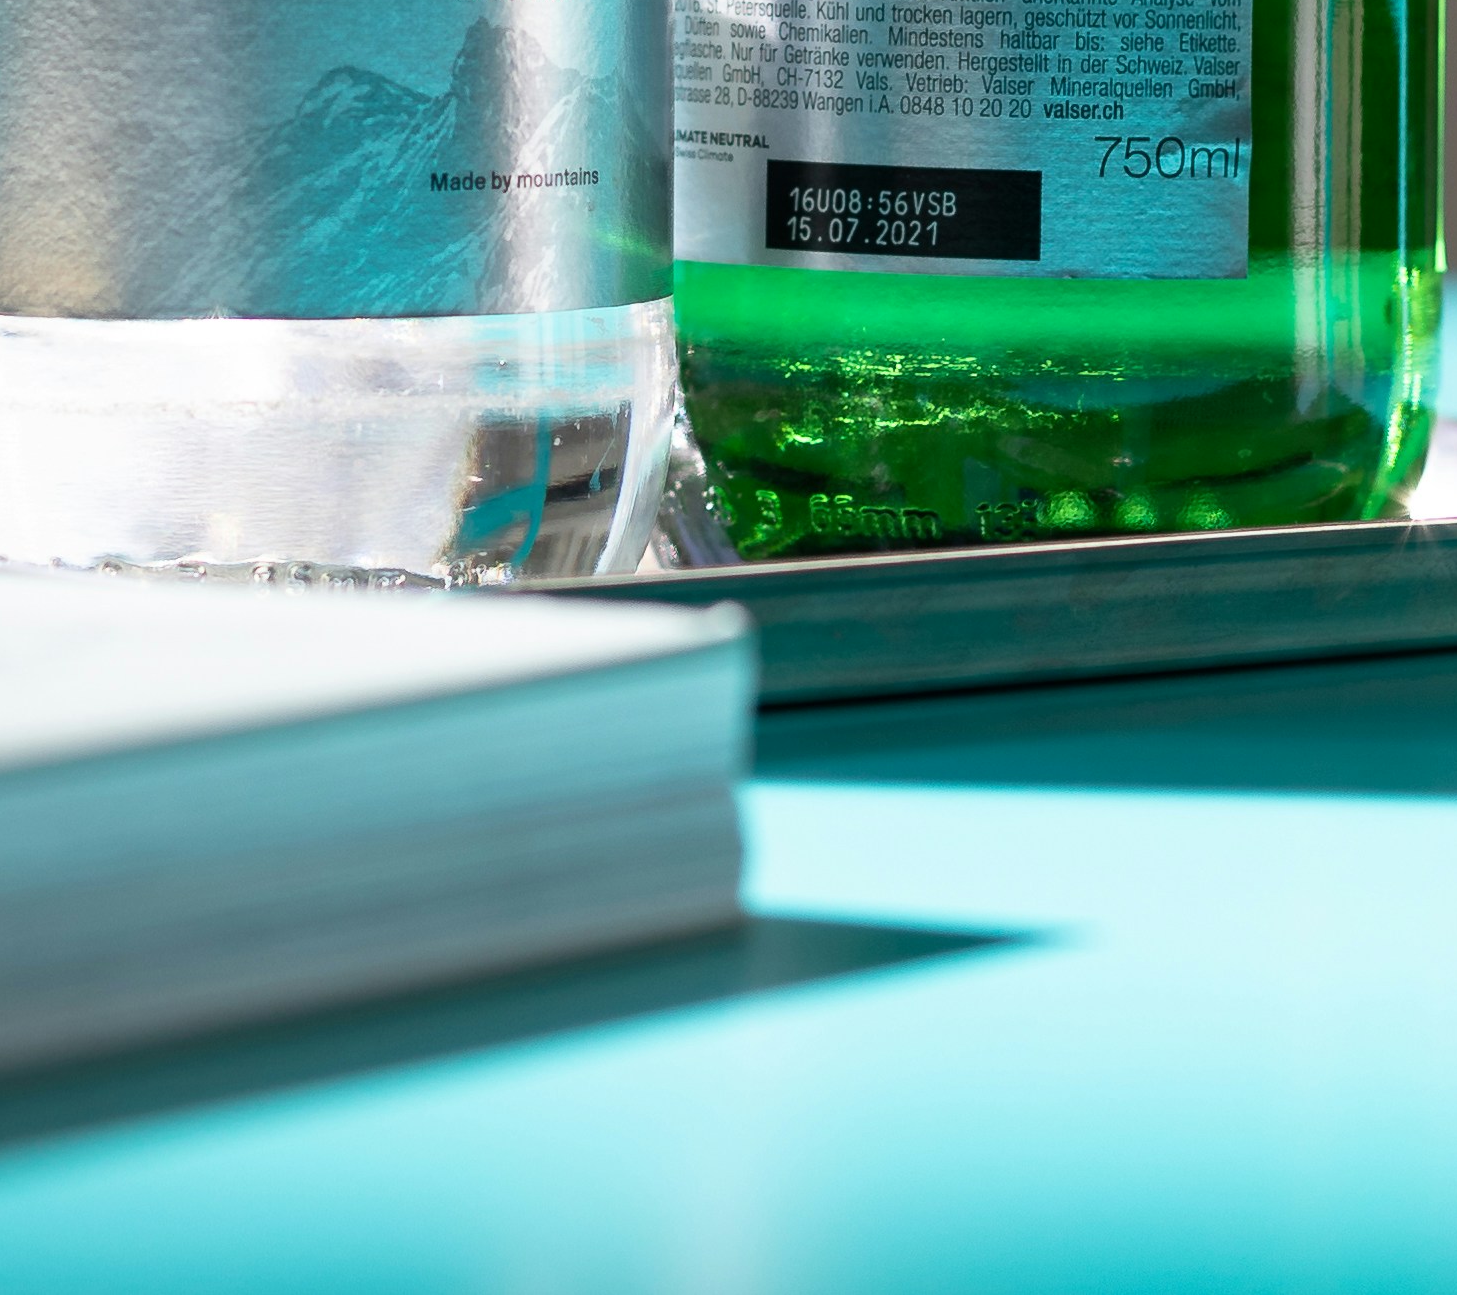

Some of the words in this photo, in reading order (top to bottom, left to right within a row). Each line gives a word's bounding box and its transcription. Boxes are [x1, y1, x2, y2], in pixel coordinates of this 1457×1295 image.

[817, 1, 849, 21] Kühl
[856, 3, 885, 22] und
[892, 4, 952, 24] trocken
[960, 6, 1018, 30] lagern,
[1025, 8, 1106, 31] geschützt
[1113, 14, 1139, 29] vor
[1145, 10, 1241, 33] Sonnenlicht,
[730, 20, 766, 40] sowie
[779, 22, 873, 44] Chemikalien.
[889, 27, 984, 48] Mindestens
[1000, 30, 1060, 50] haltbar
[1076, 32, 1105, 52] bis:
[1120, 33, 1164, 52] siehe
[1180, 33, 1240, 53] Etikette.
[732, 41, 753, 61] Nur
[760, 43, 778, 63] für
[784, 44, 849, 66] Getränke
[857, 50, 950, 70] verwenden.
[958, 52, 1049, 76] Hergestellt
[1058, 54, 1071, 74] in
[1081, 55, 1108, 74] der
[1116, 56, 1187, 75] Schweiz.
[1194, 57, 1240, 76] Valser
[723, 64, 765, 87] GmbH,
[777, 67, 844, 89] CH-7132
[856, 71, 893, 92] Vals.
[906, 73, 969, 94] Vetrieb:
[982, 75, 1034, 95] Valser
[1050, 77, 1173, 101] Mineralquellen
[1188, 79, 1240, 101] GmbH,
[715, 86, 734, 109] 28,
[738, 87, 799, 110] D-88239
[803, 91, 863, 116] Wangen
[900, 96, 945, 116] 0848
[952, 97, 974, 117] 10
[980, 98, 1003, 117] 20
[1009, 99, 1032, 118] 20
[1043, 100, 1124, 120] valser.ch
[710, 131, 769, 149] NEUTRAL
[1094, 136, 1240, 178] 750ml
[430, 172, 486, 192] Made
[491, 171, 511, 193] by
[517, 167, 599, 189] mountains
[786, 216, 938, 246] 15.07.2021
